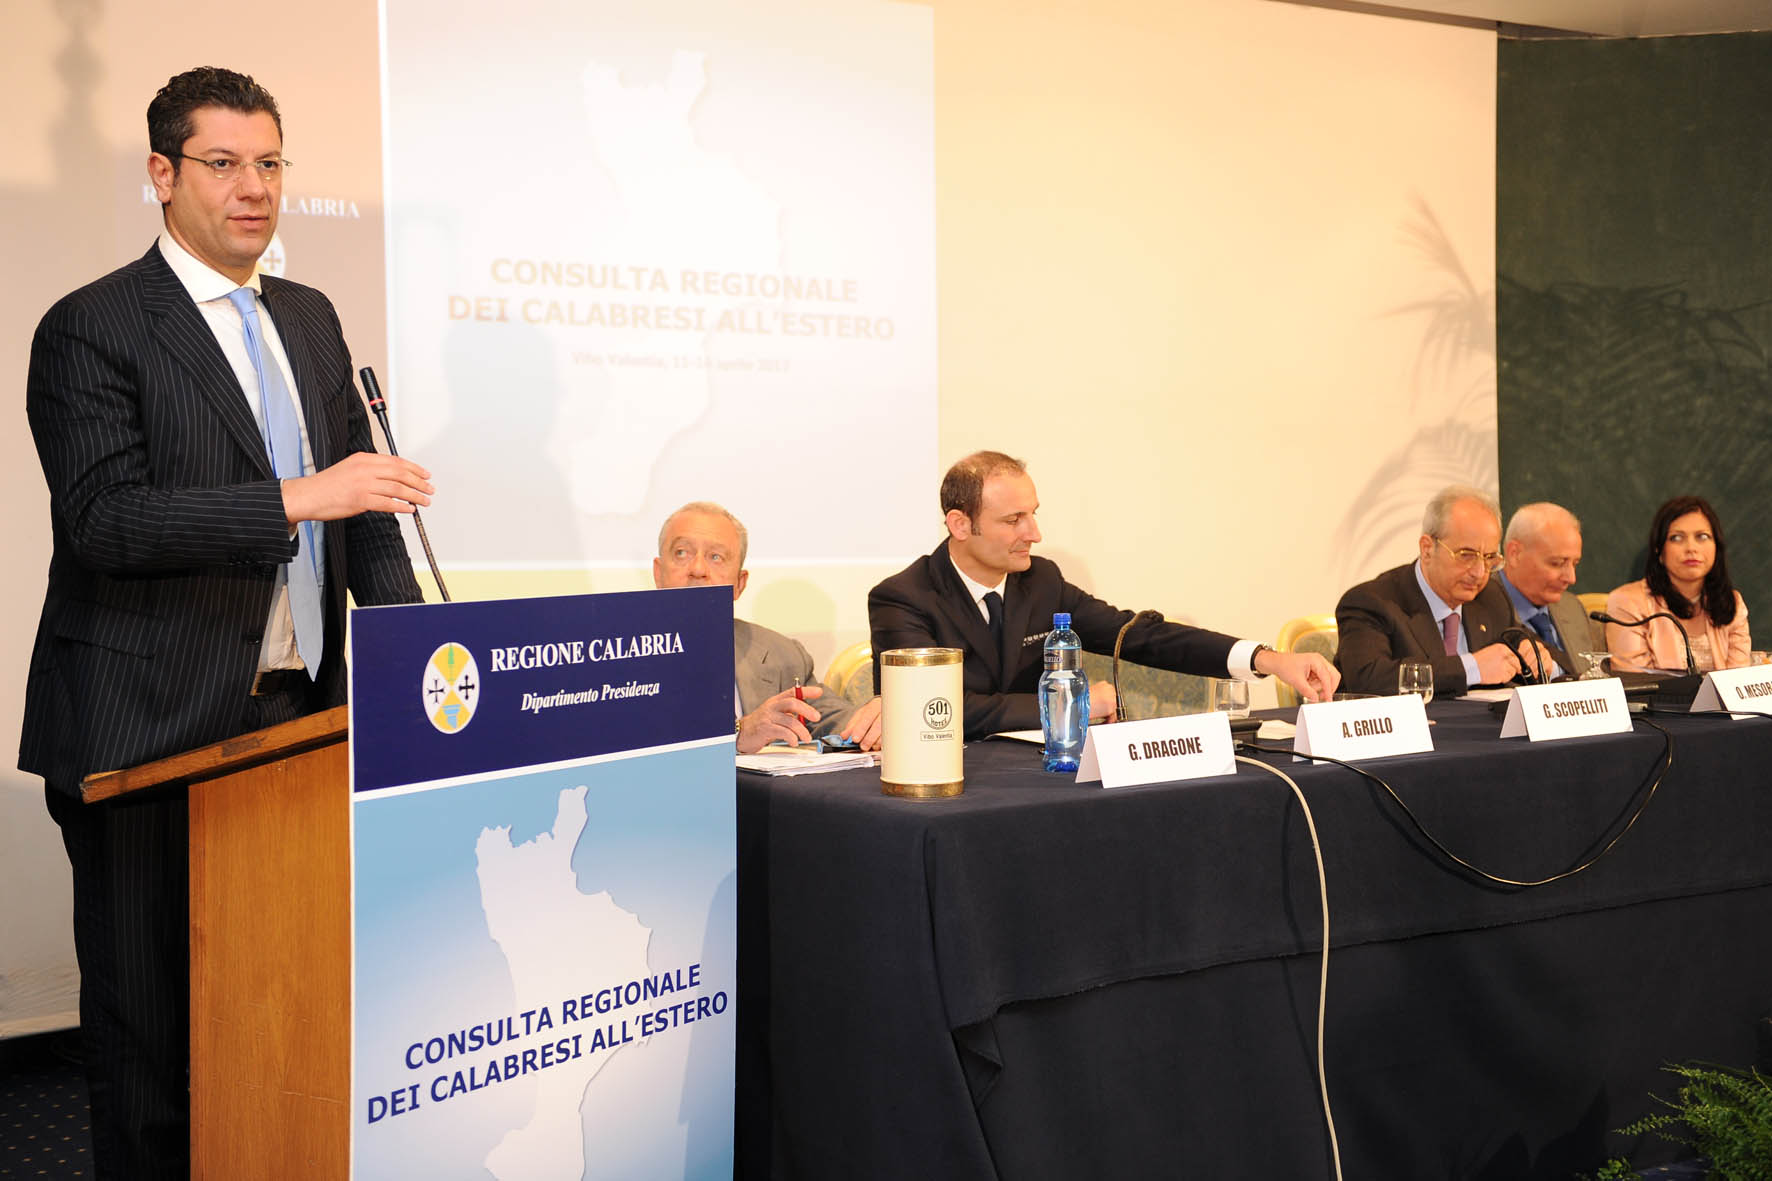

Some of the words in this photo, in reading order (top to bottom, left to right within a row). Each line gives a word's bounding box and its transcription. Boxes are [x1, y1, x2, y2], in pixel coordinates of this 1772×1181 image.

[281, 192, 360, 218] LABRIA
[490, 258, 669, 293] CONSULTA
[681, 269, 858, 303] REGIONALE
[448, 295, 510, 324] DEI
[521, 299, 706, 332] CALABRESI
[716, 311, 896, 342] ALL'ESTERO
[490, 640, 585, 672] REGIONE
[588, 631, 685, 661] CALABRIA
[521, 687, 599, 714] Dipartimento
[601, 680, 660, 701] Presidenza
[1744, 681, 1772, 699] MESOR
[928, 700, 949, 716] 501
[1542, 702, 1555, 719] G.
[1555, 697, 1609, 718] SCOPELLITI
[1342, 721, 1354, 738] A.
[1354, 716, 1393, 737] GRILLO
[1128, 743, 1142, 761] G.
[1142, 736, 1203, 760] DRAGONE
[405, 1006, 554, 1071] CONSULTA
[561, 963, 701, 1026] REGIONALE
[367, 1084, 420, 1124] DEI
[430, 1034, 582, 1103] CALABRESI
[590, 991, 728, 1053] ALL'ESTERO
